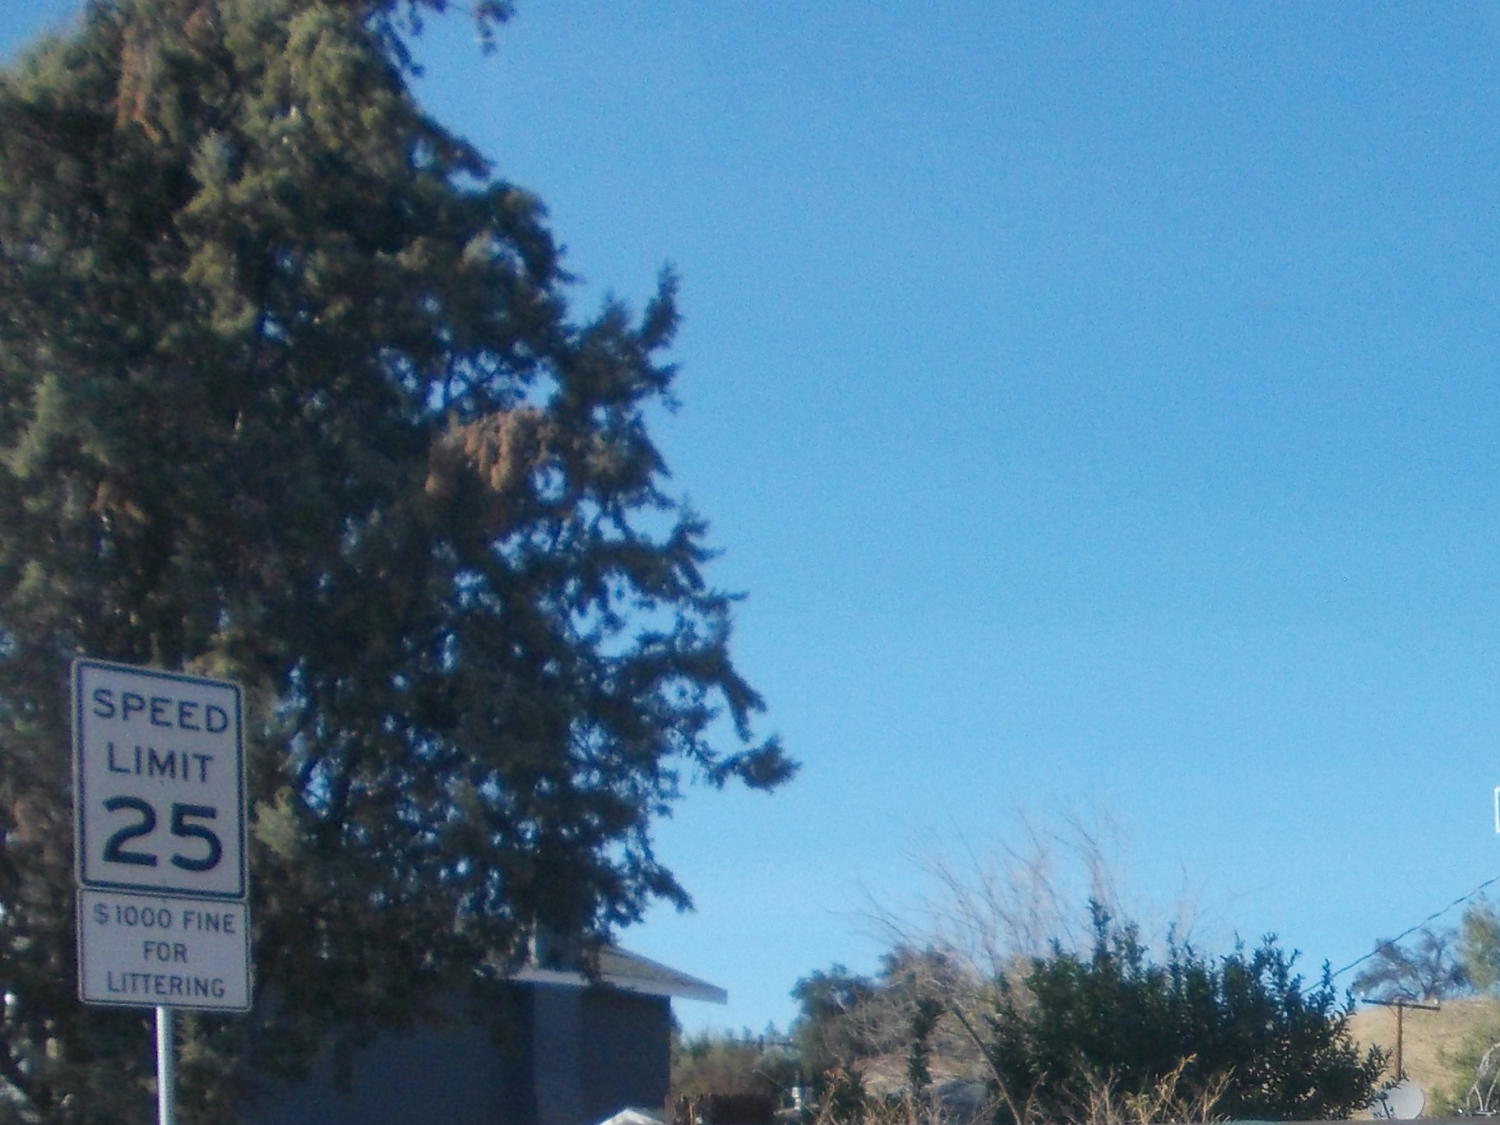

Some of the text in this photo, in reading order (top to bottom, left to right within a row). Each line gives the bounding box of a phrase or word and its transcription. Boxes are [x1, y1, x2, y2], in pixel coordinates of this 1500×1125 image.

[92, 688, 228, 733] SPEED
[107, 742, 214, 783] LIMIT
[102, 795, 222, 872] 25
[182, 910, 237, 934] FINE
[142, 940, 187, 963] FOR
[107, 971, 225, 999] LITTERING
